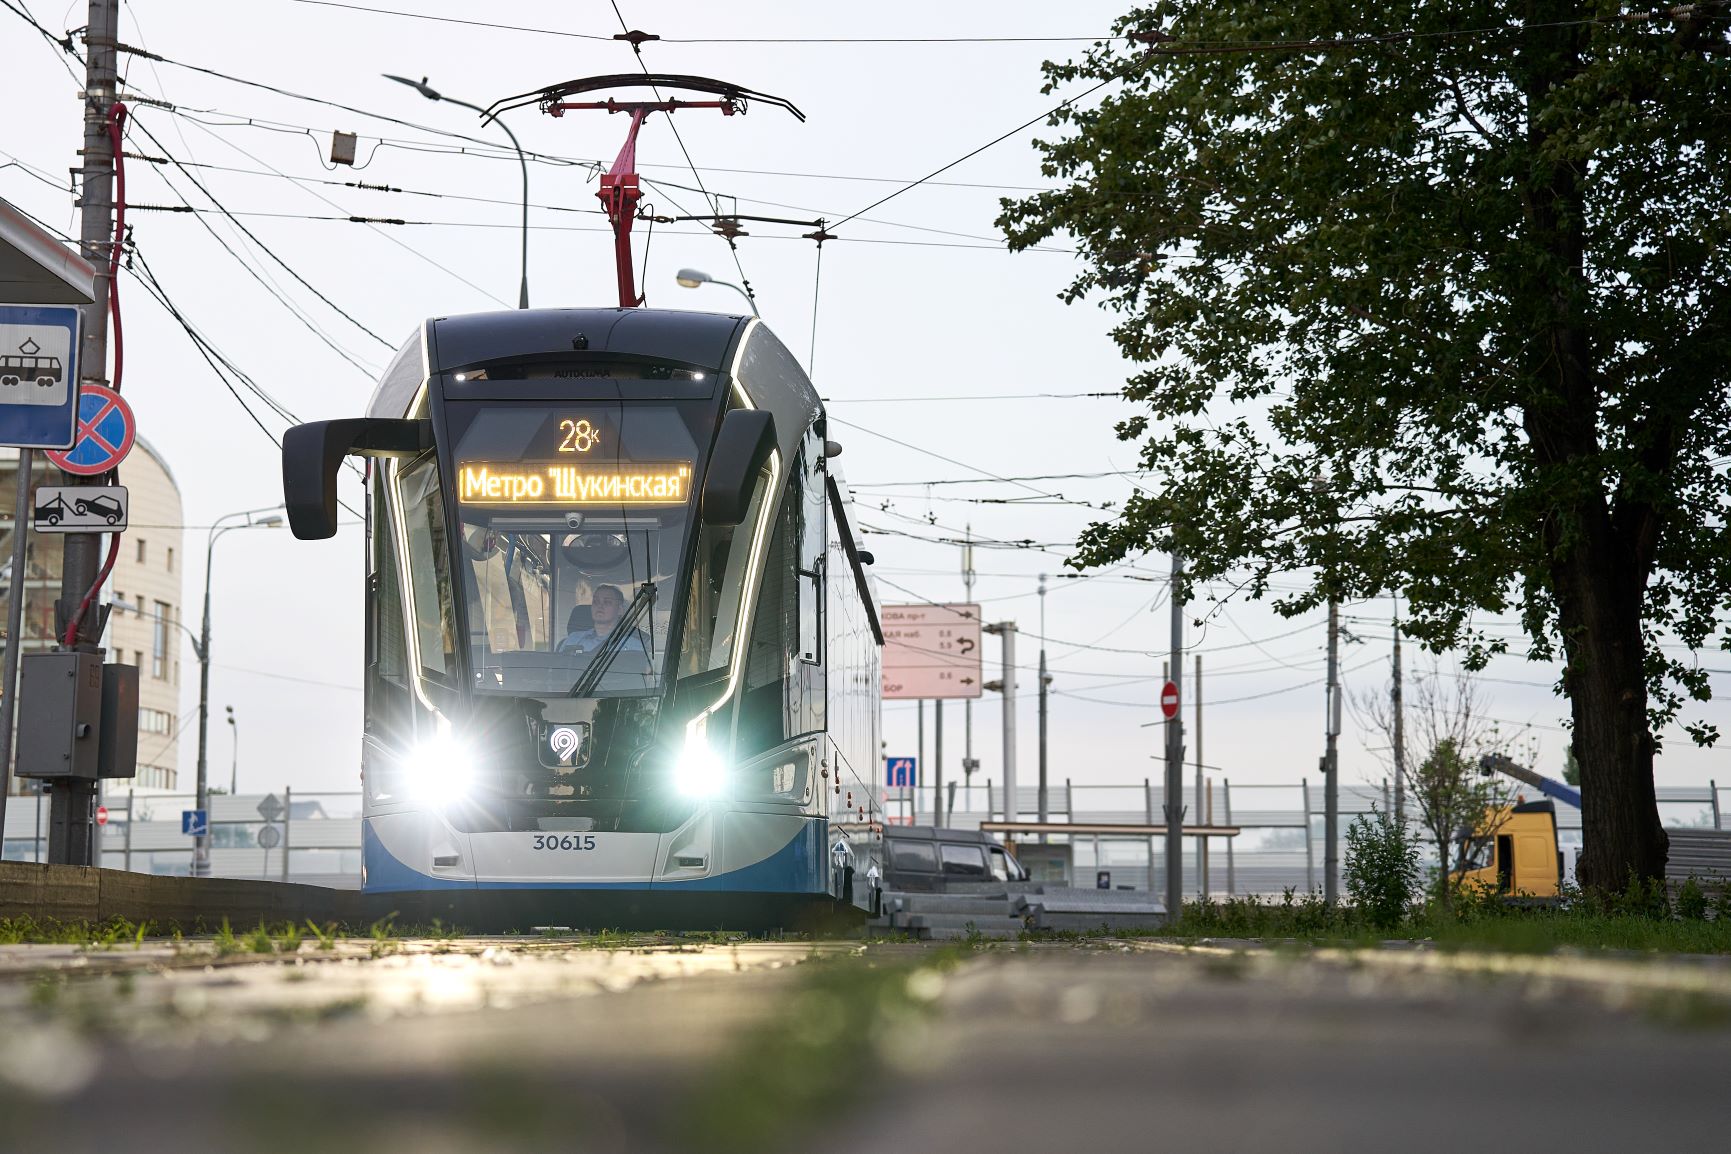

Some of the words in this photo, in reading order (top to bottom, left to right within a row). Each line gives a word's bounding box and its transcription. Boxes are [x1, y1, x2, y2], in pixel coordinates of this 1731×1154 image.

[466, 467, 543, 500] Метро
[548, 467, 688, 500] "Щукинская"
[532, 834, 597, 851] 30615
